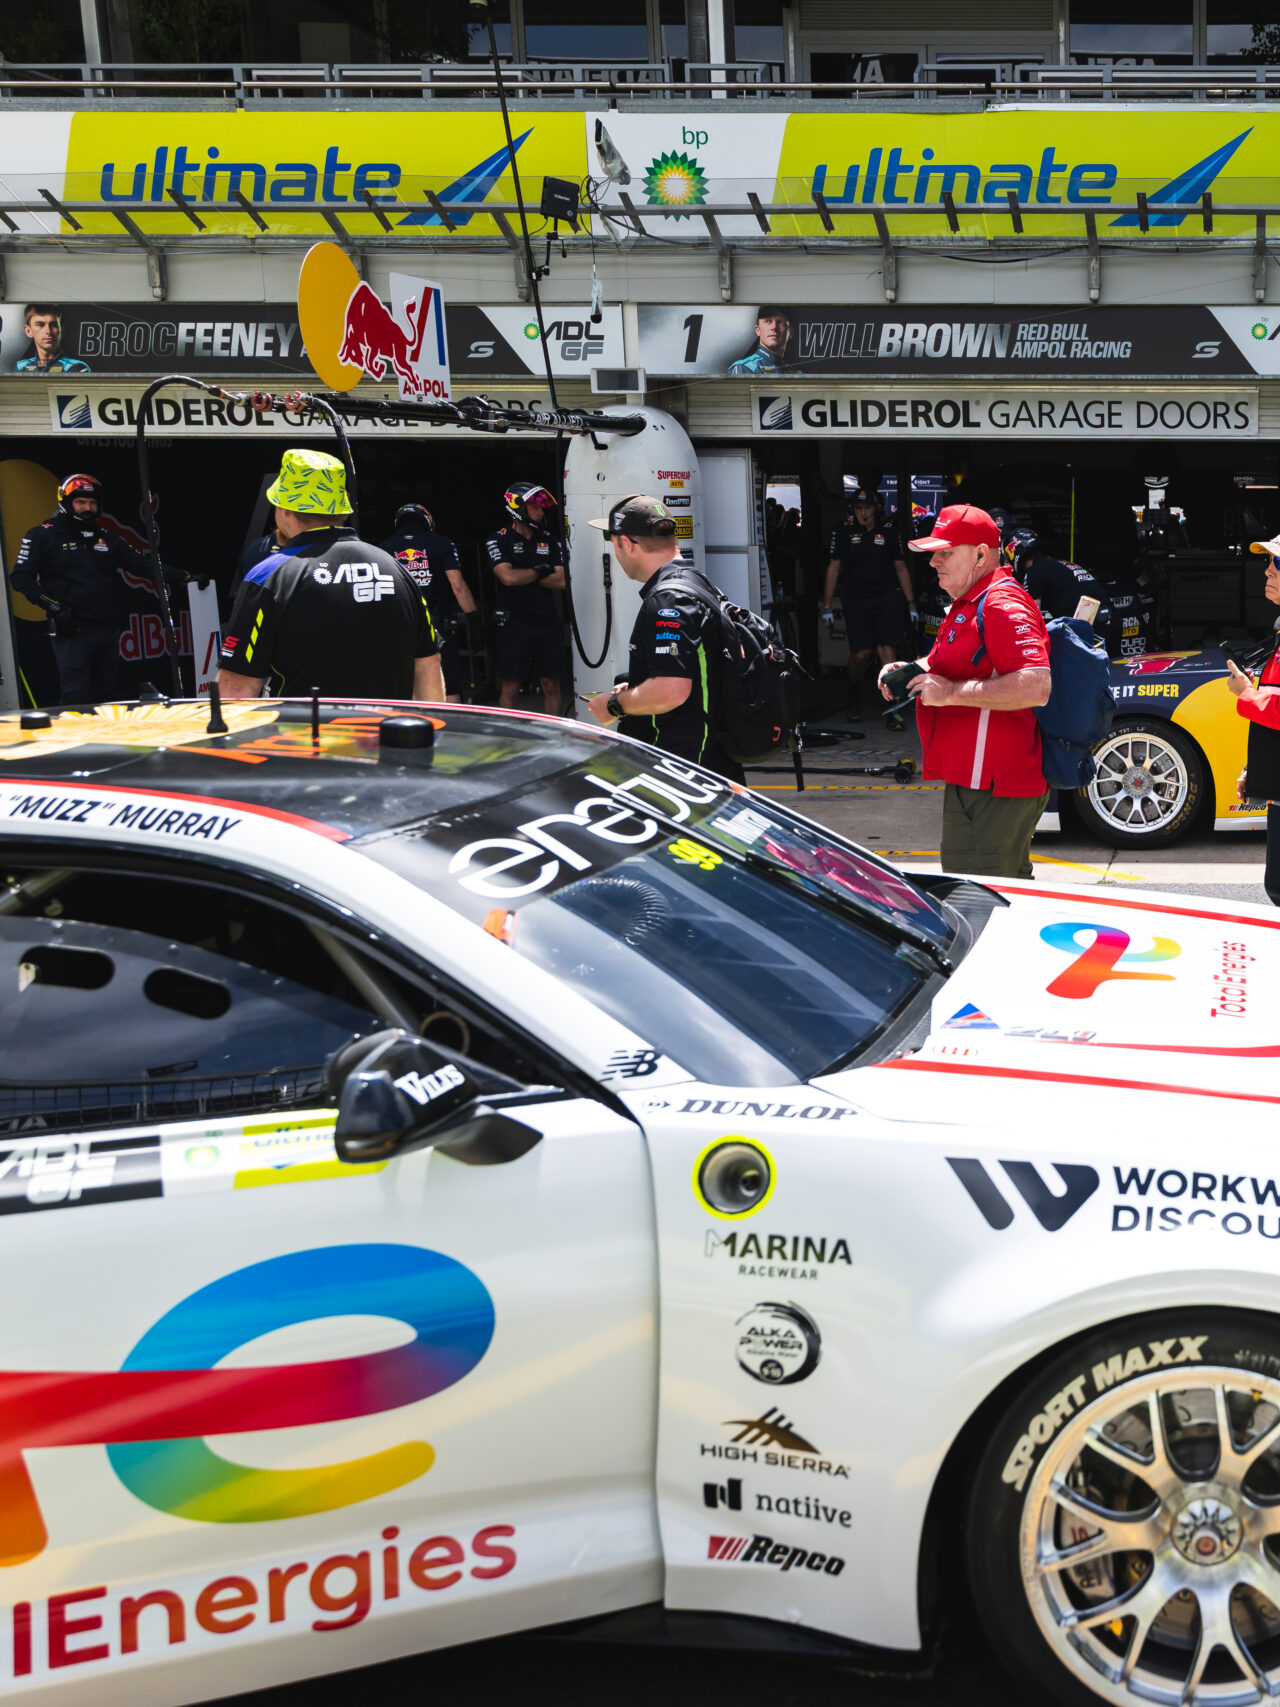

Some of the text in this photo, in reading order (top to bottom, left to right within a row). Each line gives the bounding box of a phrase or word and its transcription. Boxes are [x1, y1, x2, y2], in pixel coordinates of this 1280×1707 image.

[681, 126, 709, 150] bp
[100, 146, 402, 203] ultimate
[811, 146, 1119, 204] ultimate
[683, 314, 704, 363] 1
[1017, 323, 1089, 340] RED BULL
[560, 341, 605, 361] GF
[1011, 343, 1132, 360] AMPOL RACING
[801, 399, 1251, 431] GLIDEROL GARAGE DOORS
[332, 562, 394, 584] ADL
[353, 581, 395, 603] GF
[1123, 686, 1136, 698] IT
[1137, 684, 1180, 698] SUPER
[109, 804, 244, 841] MURRAY
[447, 755, 724, 899] erebus
[1210, 940, 1257, 1020] TotalEnergies
[678, 1097, 859, 1121] DUNLOP
[704, 1229, 854, 1265] MARINA
[738, 1264, 819, 1281] RACEWEAR
[1001, 1335, 1209, 1493] SPORT MAXX
[700, 1442, 852, 1480] HIGH SIERRA
[755, 1489, 854, 1529] natiive
[741, 1534, 847, 1578] Repco
